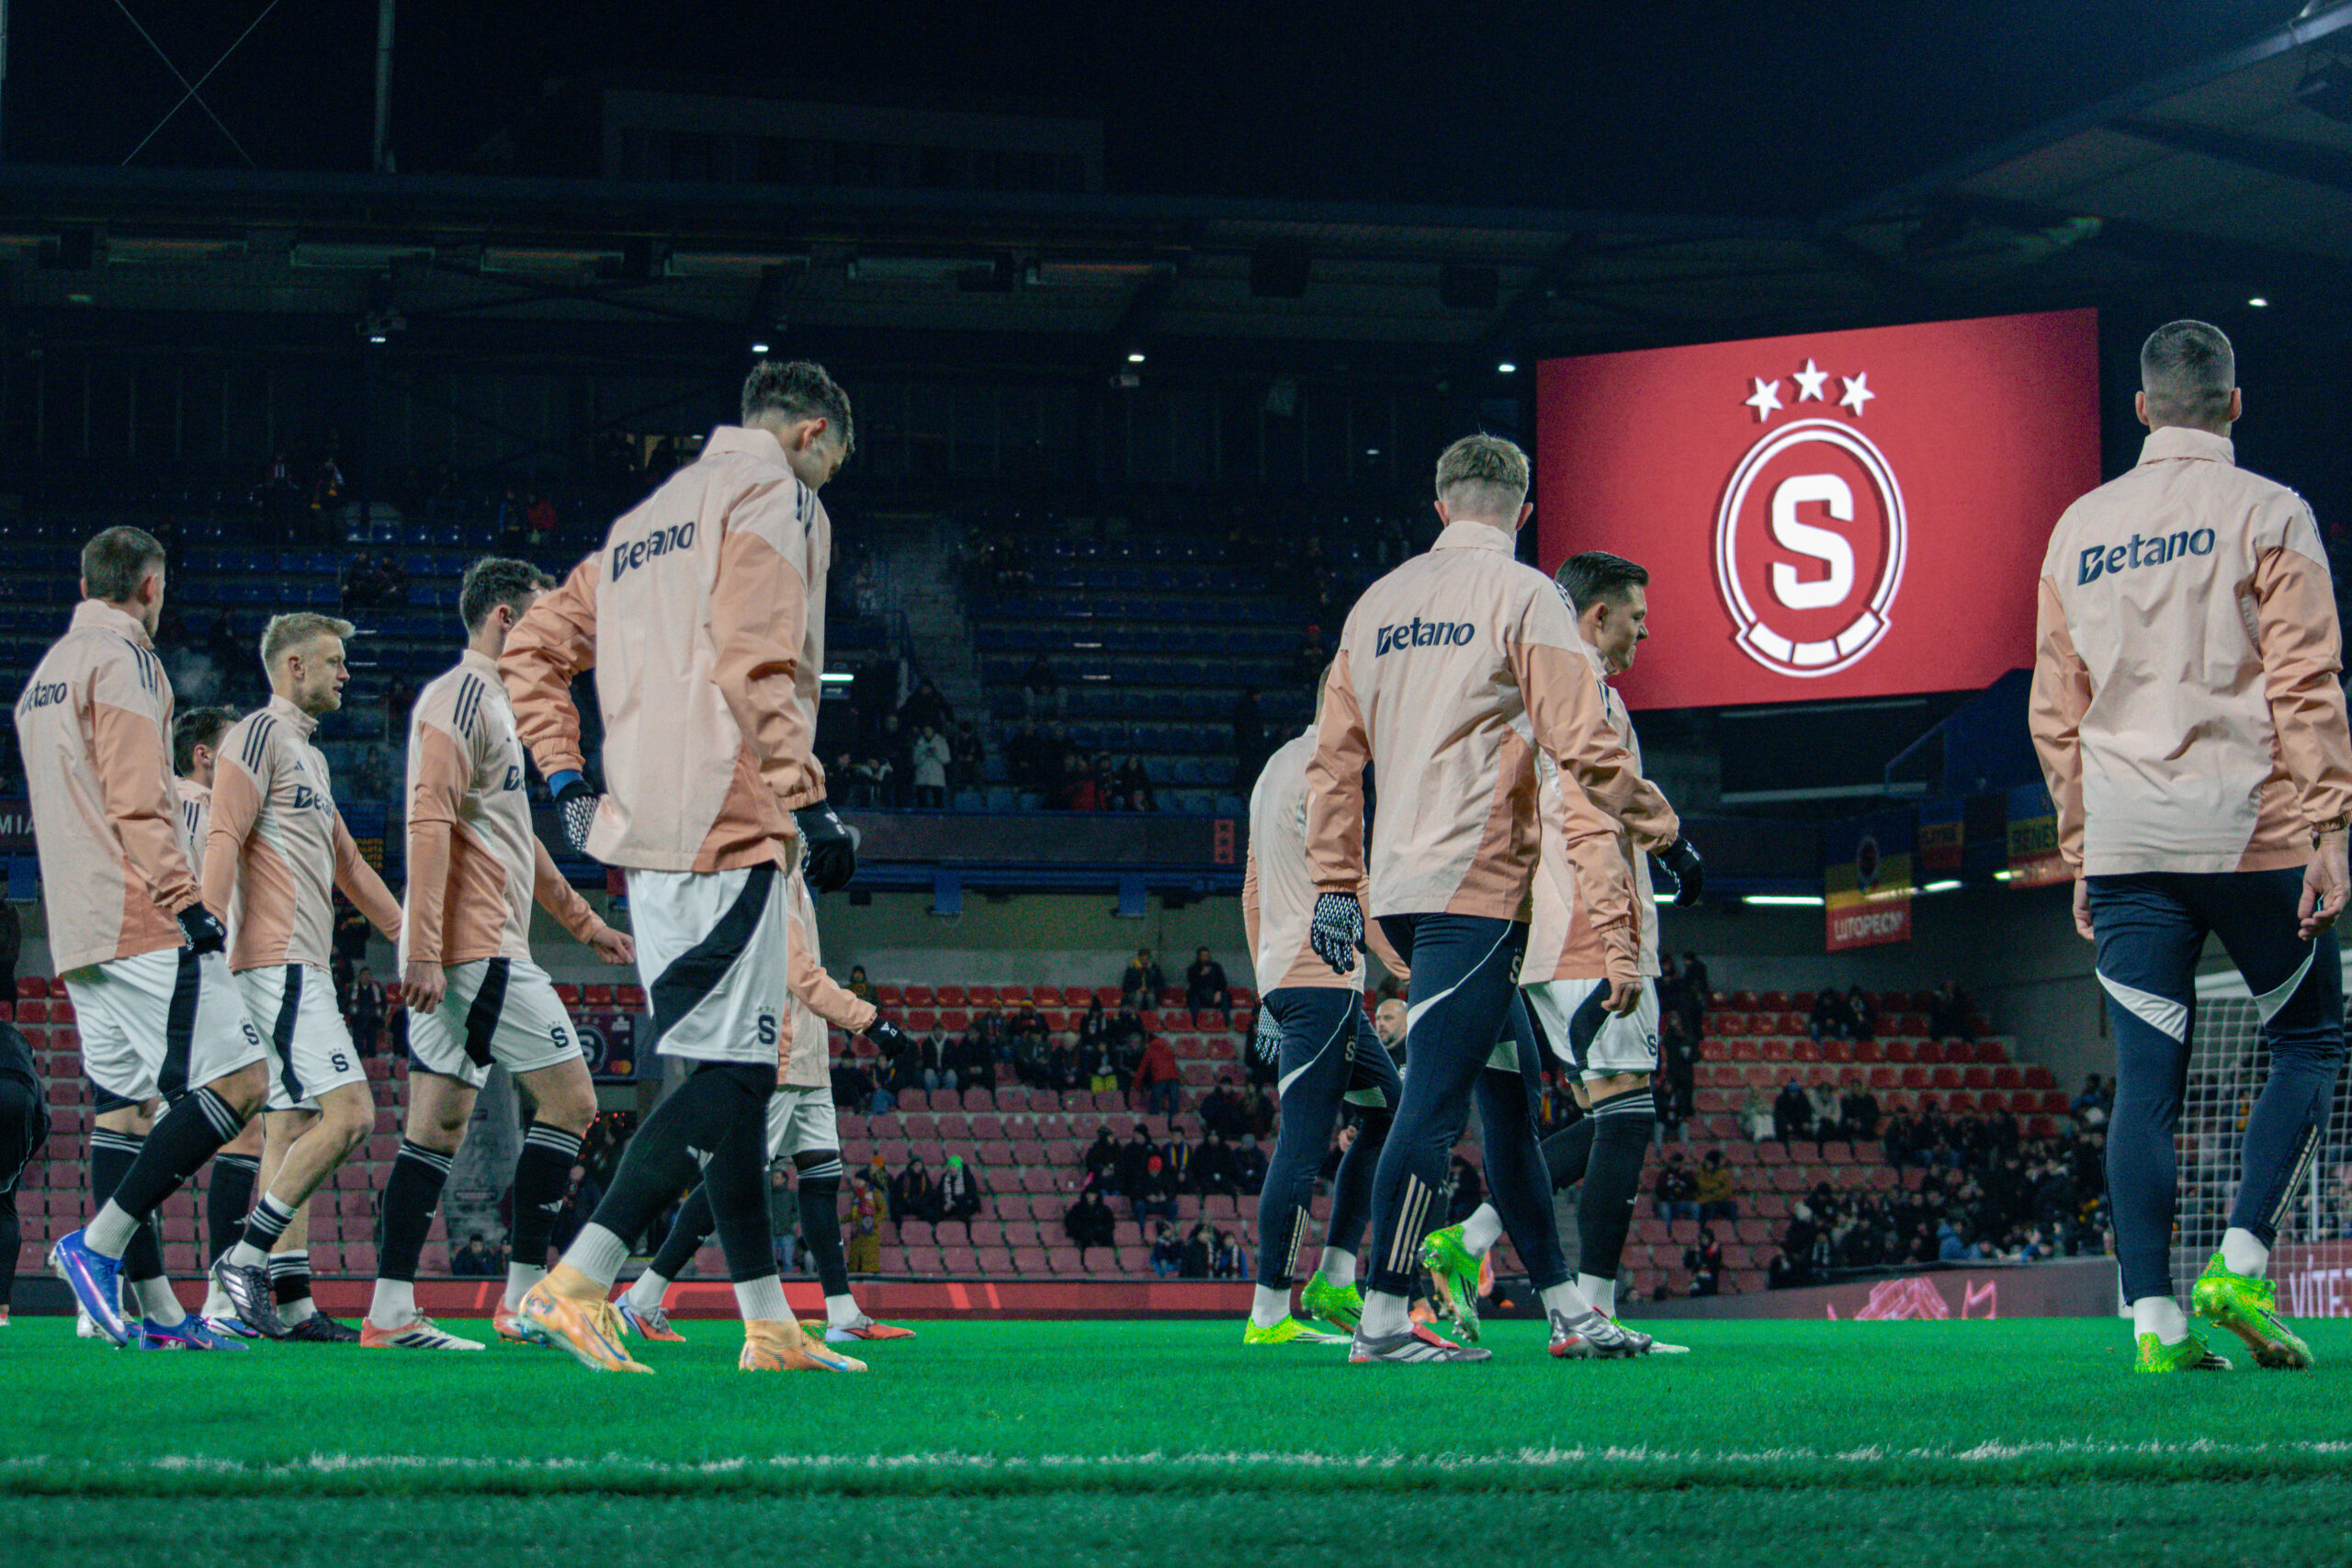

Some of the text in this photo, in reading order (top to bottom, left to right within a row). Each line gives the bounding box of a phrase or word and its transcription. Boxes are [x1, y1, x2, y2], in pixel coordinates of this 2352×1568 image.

[612, 521, 695, 583] Betano
[1772, 473, 1854, 610] S
[2077, 528, 2215, 586] Betano
[1375, 616, 1476, 659] Betano
[243, 1023, 259, 1045] S
[551, 1026, 570, 1048] S
[758, 1014, 775, 1044] S
[332, 1053, 349, 1073] S
[1345, 1041, 1356, 1062] S
